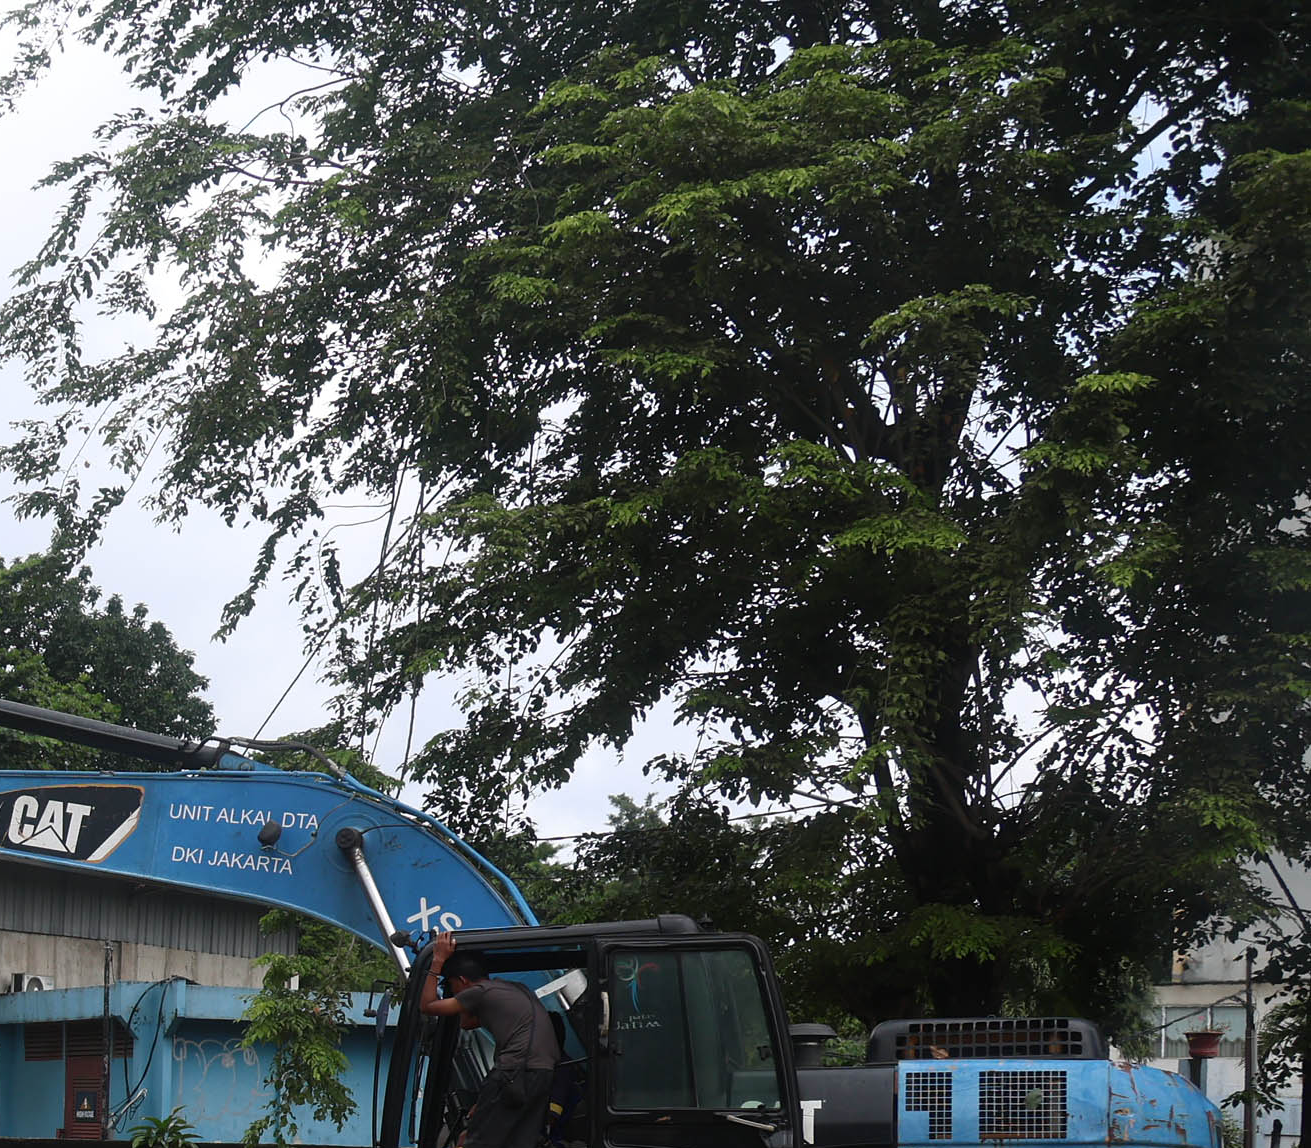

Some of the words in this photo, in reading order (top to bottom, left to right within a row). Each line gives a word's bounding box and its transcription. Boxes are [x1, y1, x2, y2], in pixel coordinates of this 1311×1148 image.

[8, 795, 92, 853] CAT
[169, 803, 214, 821] UNIT
[281, 812, 319, 829] DTA
[171, 846, 204, 864] DKI
[208, 850, 293, 875] JAKARTA
